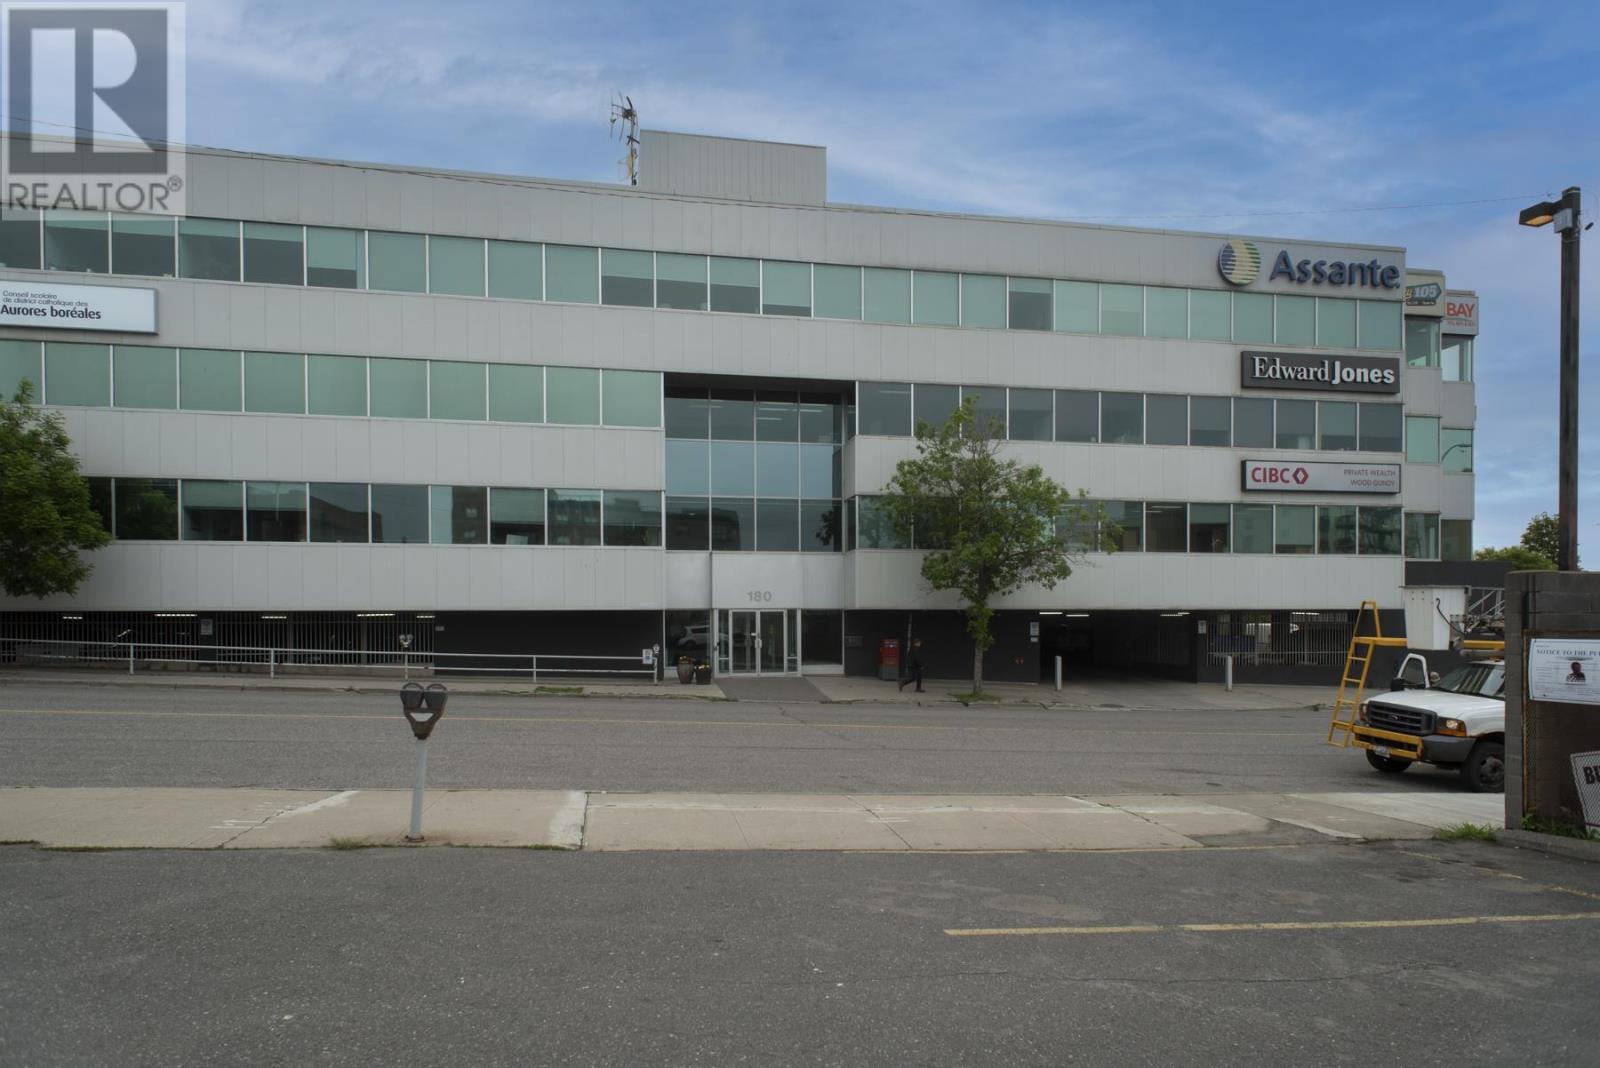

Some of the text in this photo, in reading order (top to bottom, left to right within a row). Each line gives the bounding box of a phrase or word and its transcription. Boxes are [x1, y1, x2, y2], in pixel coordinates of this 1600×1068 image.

[1269, 249, 1400, 289] Assante
[2, 290, 29, 298] Conseil
[1414, 285, 1437, 298] 105
[37, 299, 73, 307] catholique
[0, 304, 102, 320] Aurores boréales
[1446, 302, 1475, 318] BAY
[1251, 467, 1290, 484] CIBC
[1350, 479, 1373, 487] WOOD
[746, 590, 772, 602] 180
